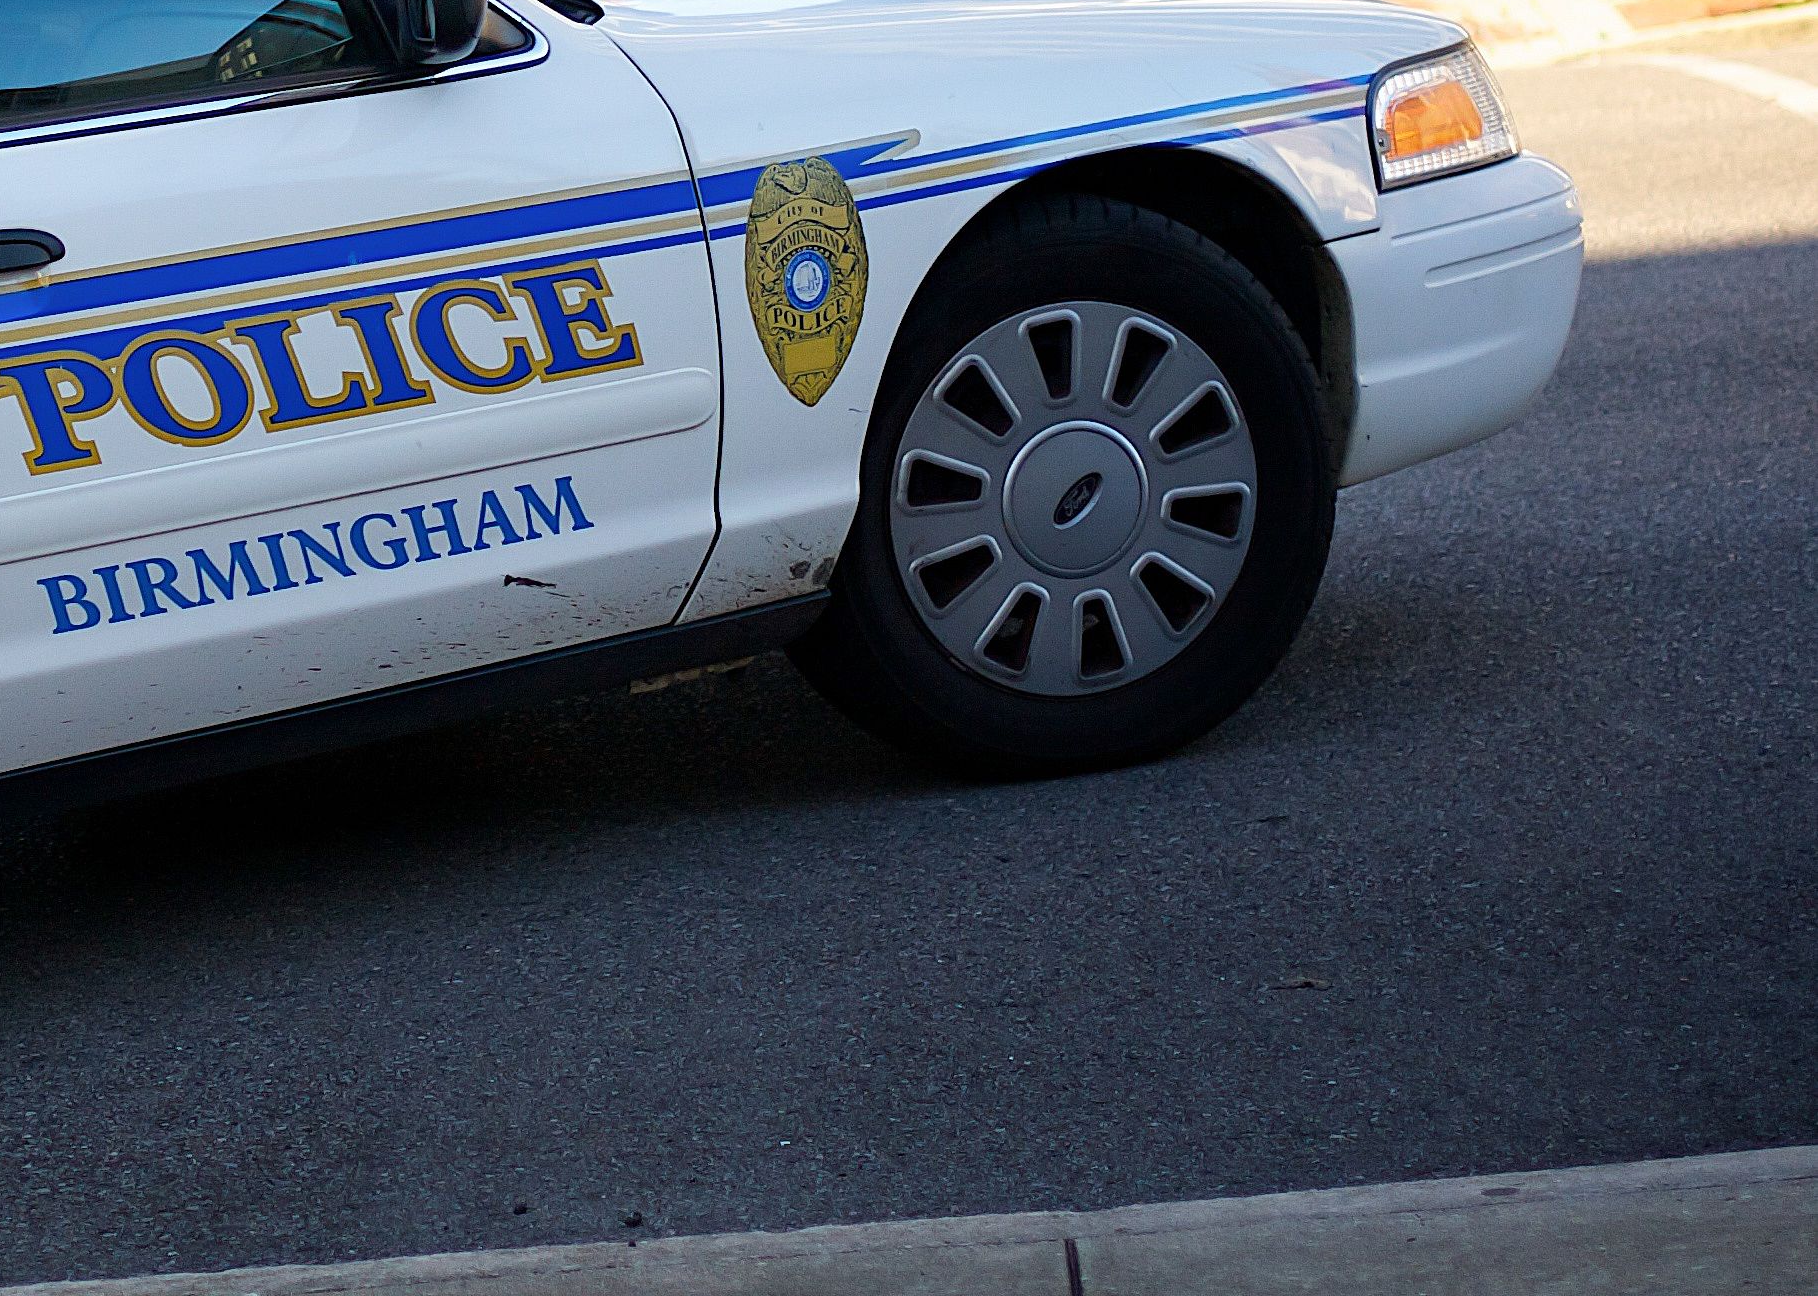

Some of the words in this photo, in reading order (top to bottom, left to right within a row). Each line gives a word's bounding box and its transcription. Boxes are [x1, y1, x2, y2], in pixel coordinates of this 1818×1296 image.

[770, 229, 840, 263] BIRMINGHAM
[773, 298, 847, 330] POLICE
[37, 476, 594, 635] BIRMINGHAM
